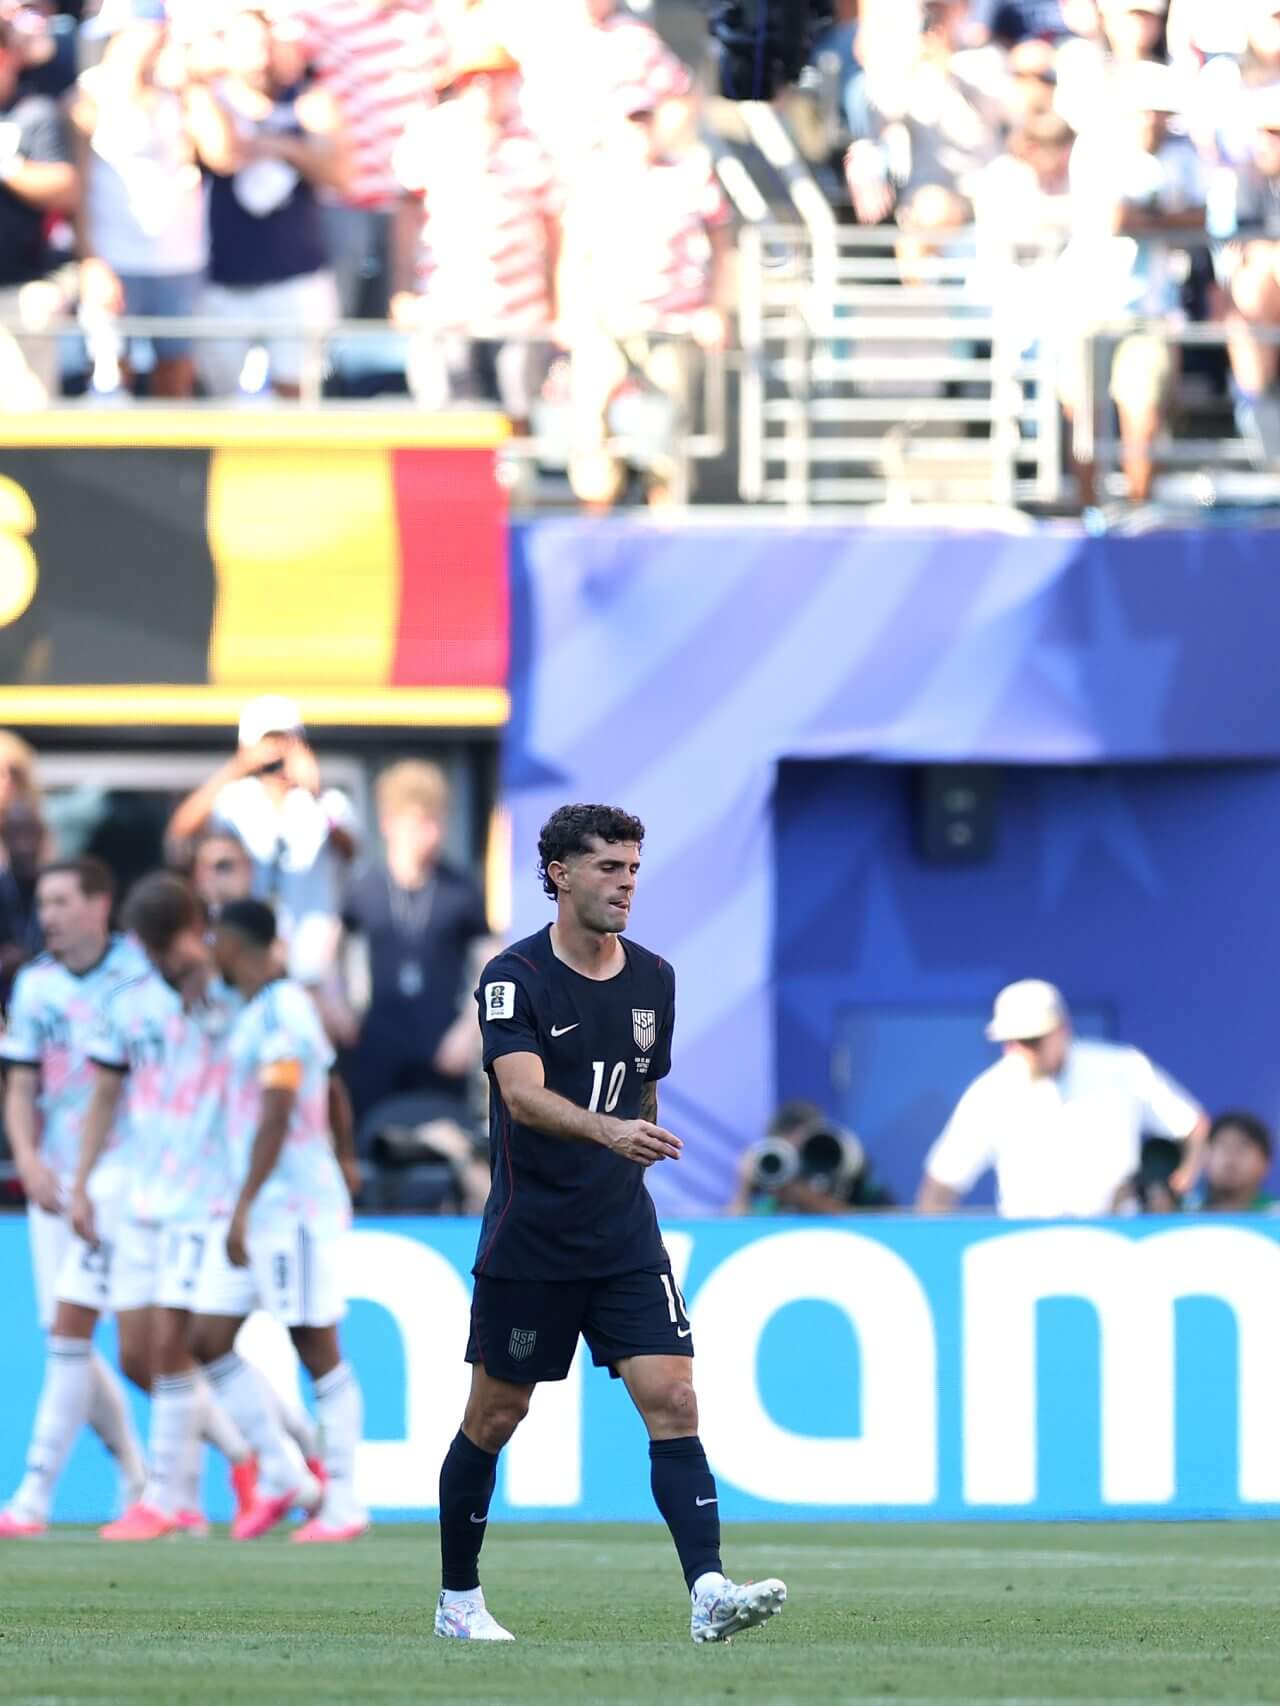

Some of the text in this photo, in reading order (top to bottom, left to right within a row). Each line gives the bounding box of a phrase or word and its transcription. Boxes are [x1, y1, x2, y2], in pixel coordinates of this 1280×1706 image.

[634, 1011, 654, 1028] USA
[588, 1061, 626, 1113] 10
[513, 1330, 535, 1345] USA
